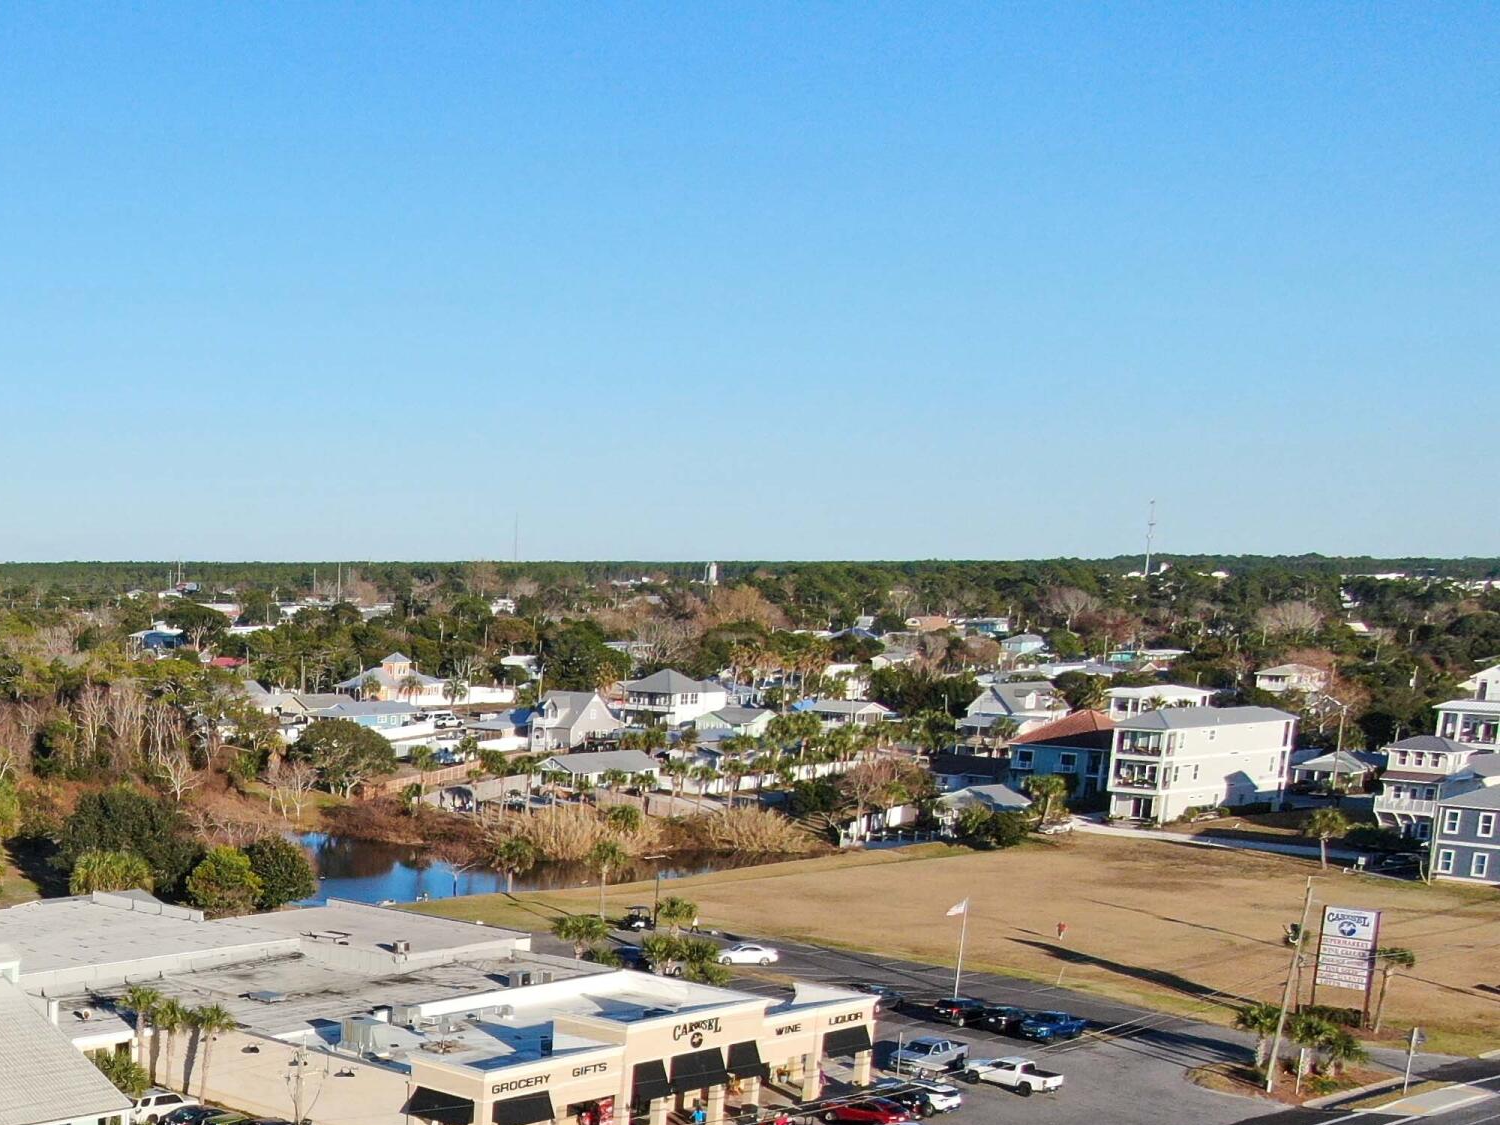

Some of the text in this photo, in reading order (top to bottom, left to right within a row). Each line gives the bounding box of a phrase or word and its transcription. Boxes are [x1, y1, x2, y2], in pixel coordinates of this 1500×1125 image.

[828, 1011, 863, 1026] LIQUOR
[673, 1017, 722, 1041] CAROUSEL
[775, 1023, 802, 1036] WINE
[571, 1062, 608, 1078] GIFTS
[491, 1073, 551, 1094] GROCERY
